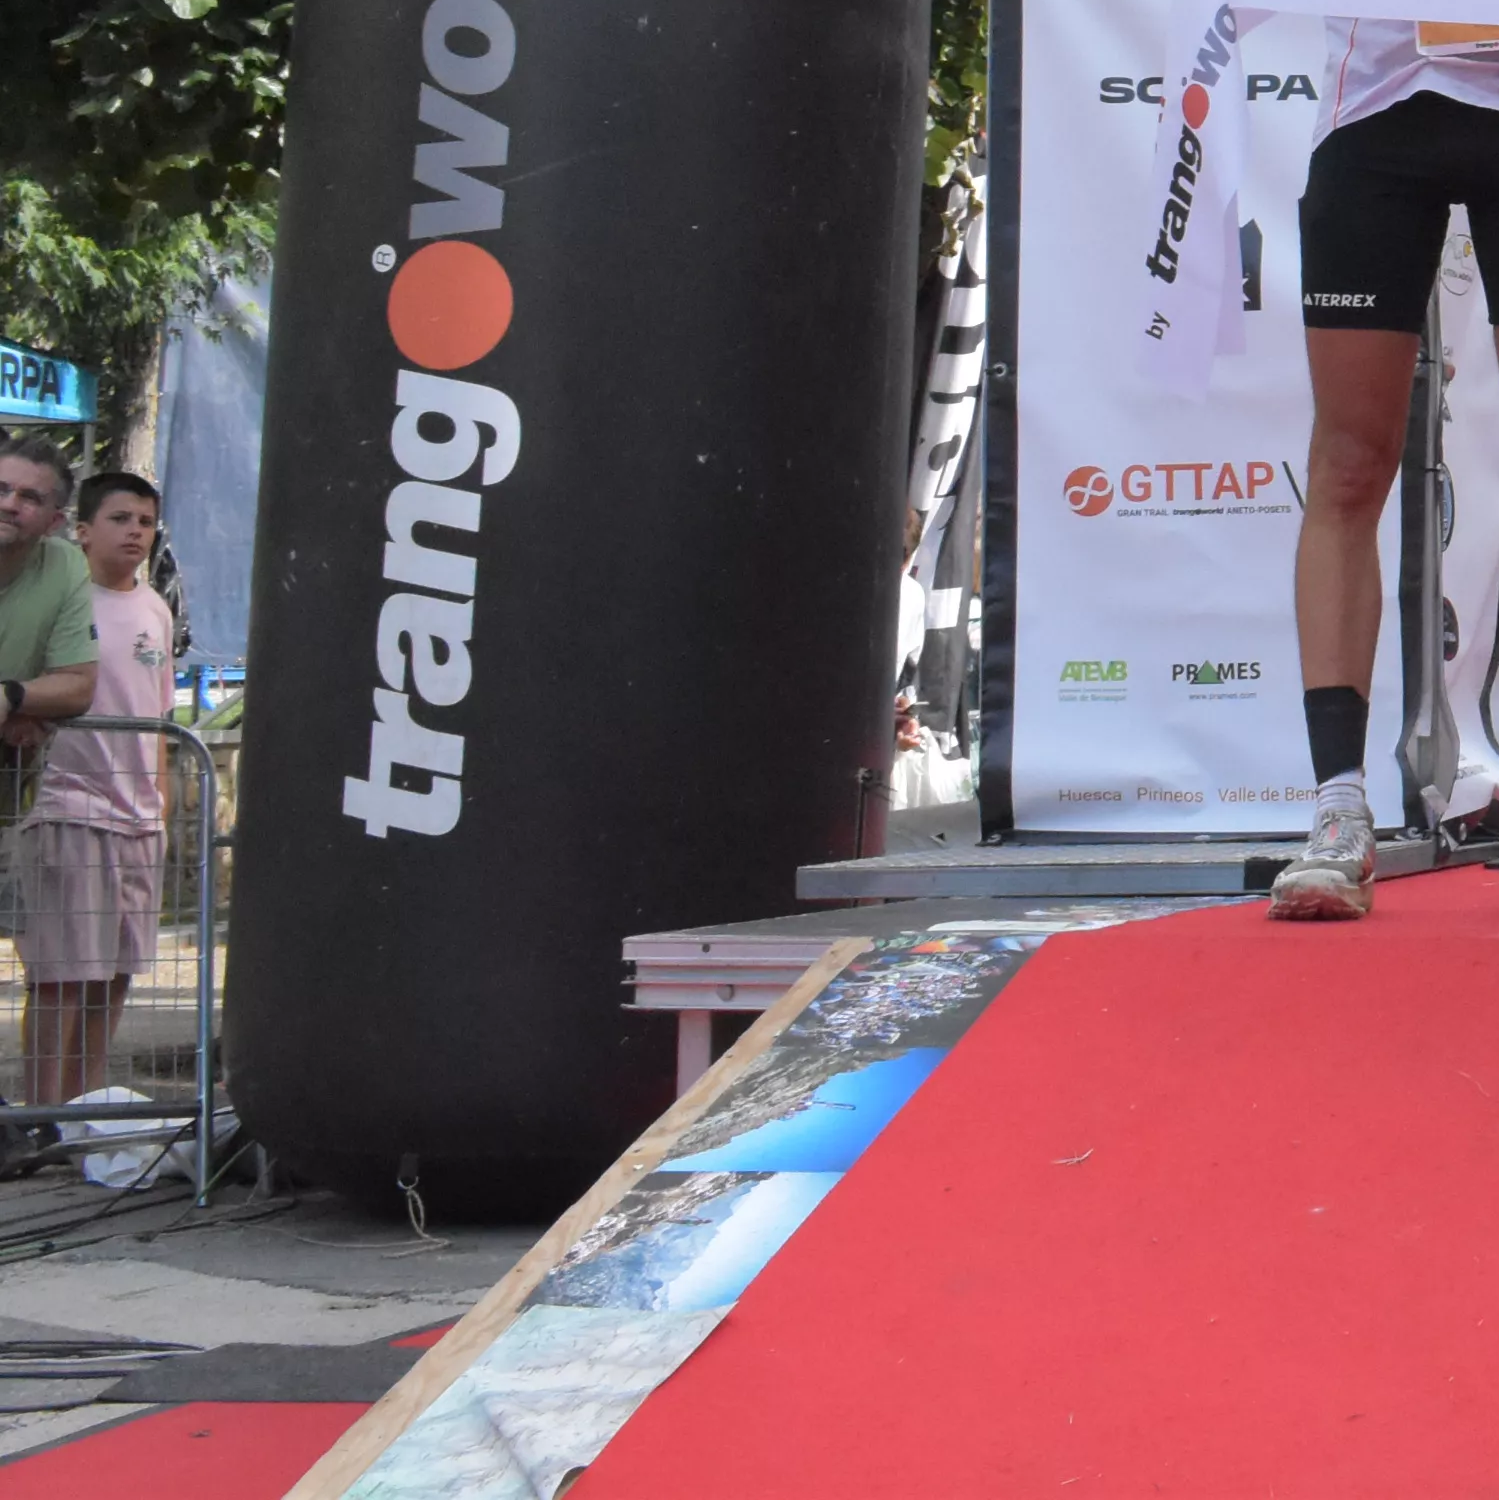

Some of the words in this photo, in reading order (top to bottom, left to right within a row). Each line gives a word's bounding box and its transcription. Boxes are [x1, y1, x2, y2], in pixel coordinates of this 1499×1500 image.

[1100, 74, 1319, 104] SCPA
[1313, 293, 1376, 308] TERREX
[1146, 311, 1171, 340] by
[1121, 461, 1275, 503] GTTAP
[1117, 509, 1142, 517] GRAN
[1144, 508, 1169, 517] TRAIL
[1227, 504, 1292, 514] ANETO-POSETS
[1172, 660, 1261, 684] PRAMES
[1059, 787, 1122, 802] Huesca
[1136, 787, 1204, 803] Pirineos
[1218, 787, 1257, 802] Valle
[1261, 786, 1281, 802] de
